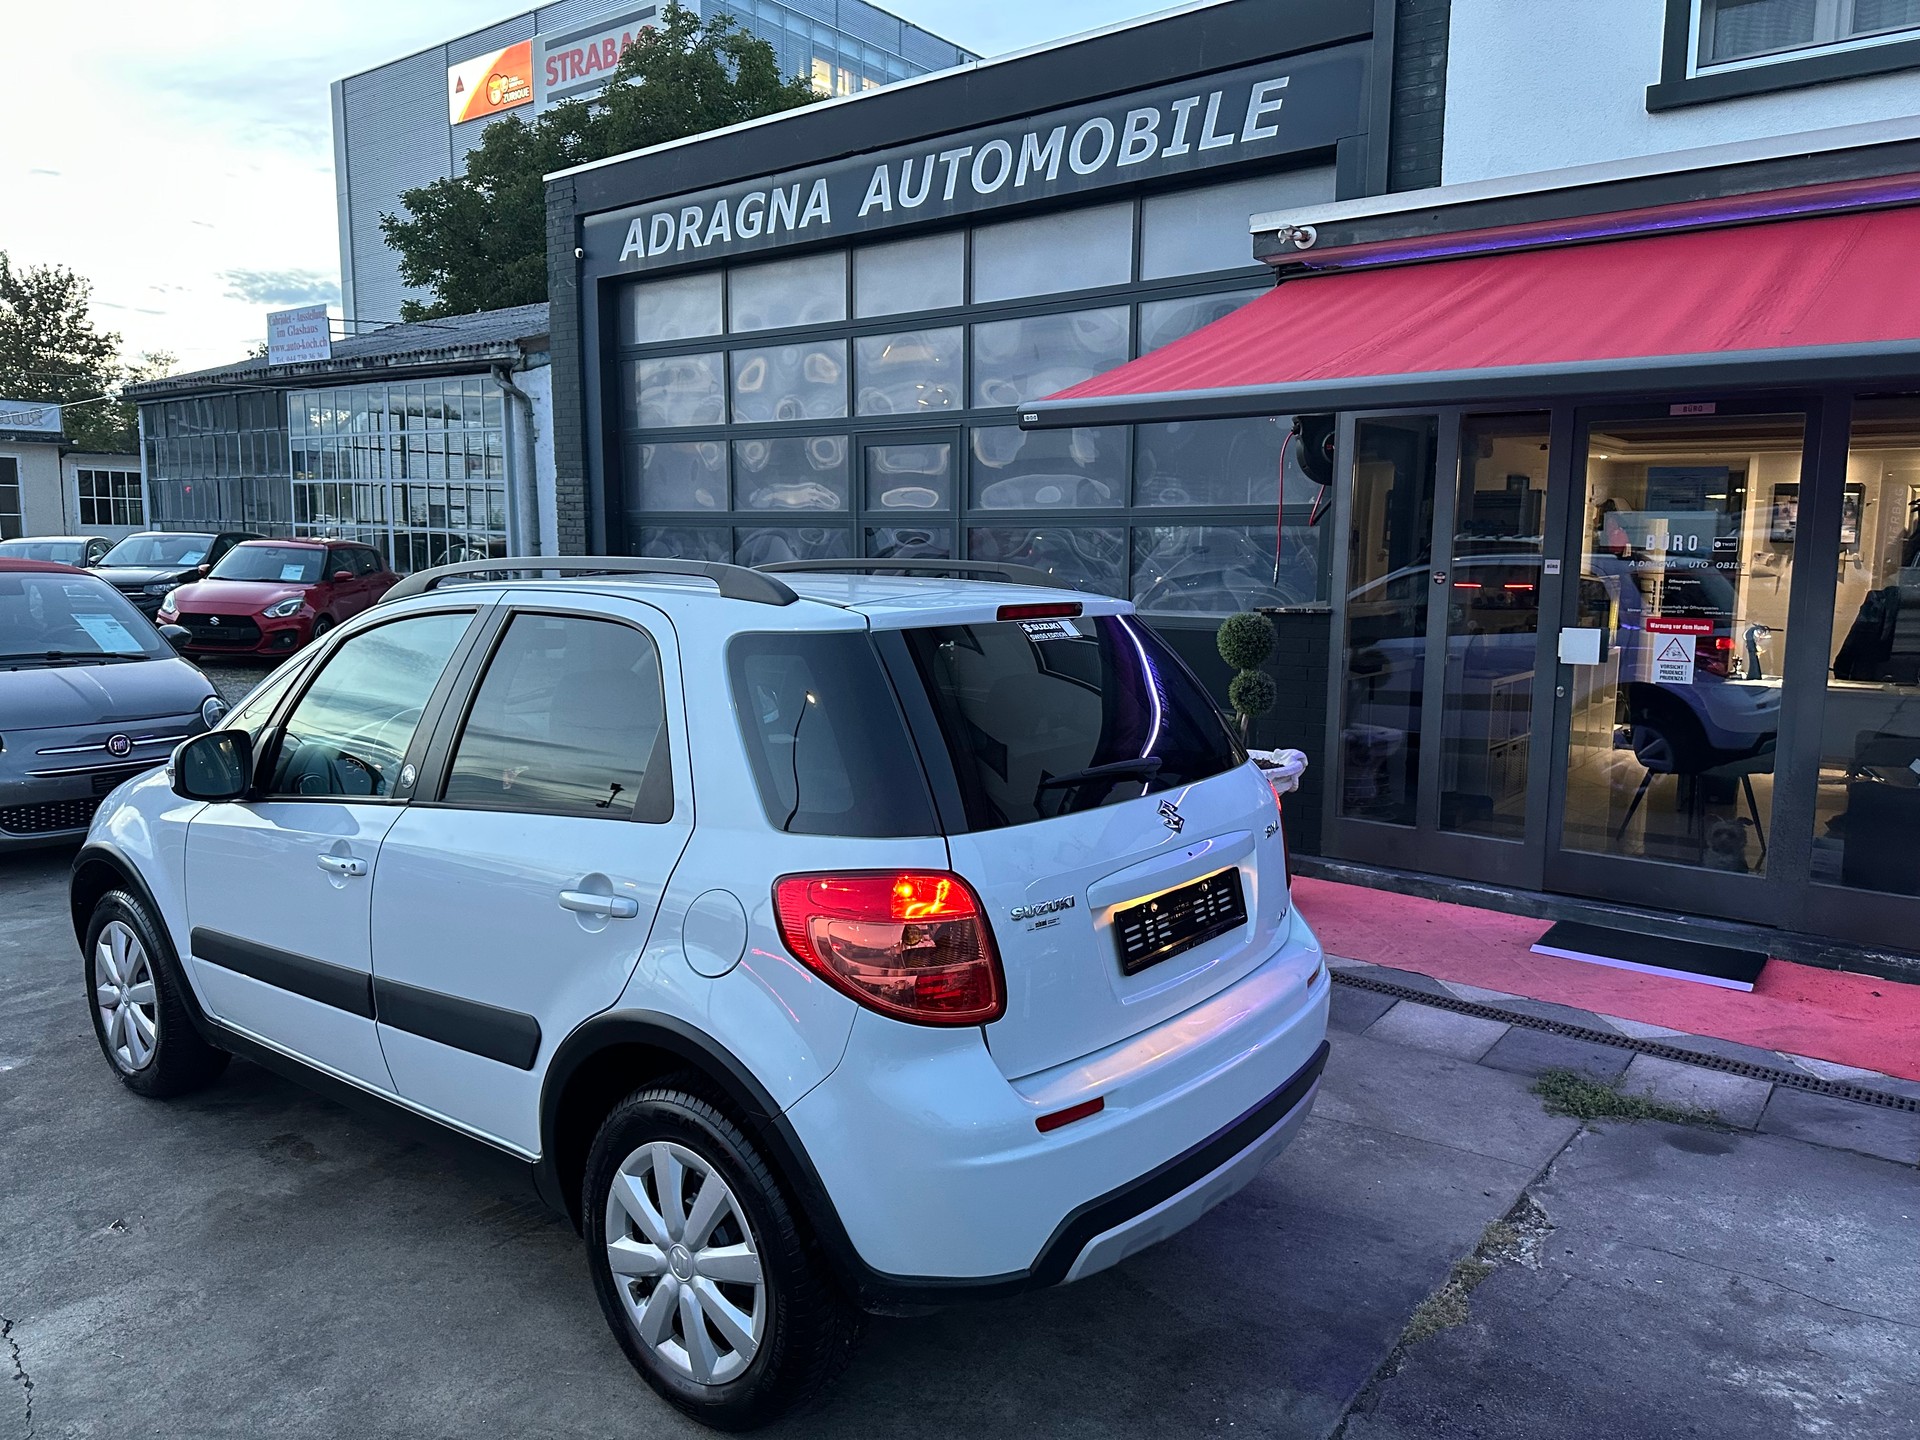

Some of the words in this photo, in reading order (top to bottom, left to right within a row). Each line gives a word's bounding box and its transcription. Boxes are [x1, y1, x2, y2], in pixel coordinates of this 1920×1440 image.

[503, 87, 530, 104] ZURIQUE
[619, 178, 832, 262] ADRAGNA
[857, 76, 1290, 217] AUTOMOBILE
[276, 327, 286, 338] im
[287, 324, 319, 337] Glashaus
[270, 337, 328, 352] www.auto-koch.ch
[1645, 531, 1698, 551] BÜRO
[1031, 622, 1061, 631] SUZUKI
[1650, 622, 1672, 630] Warnung
[1010, 895, 1075, 921] SUZUKI
